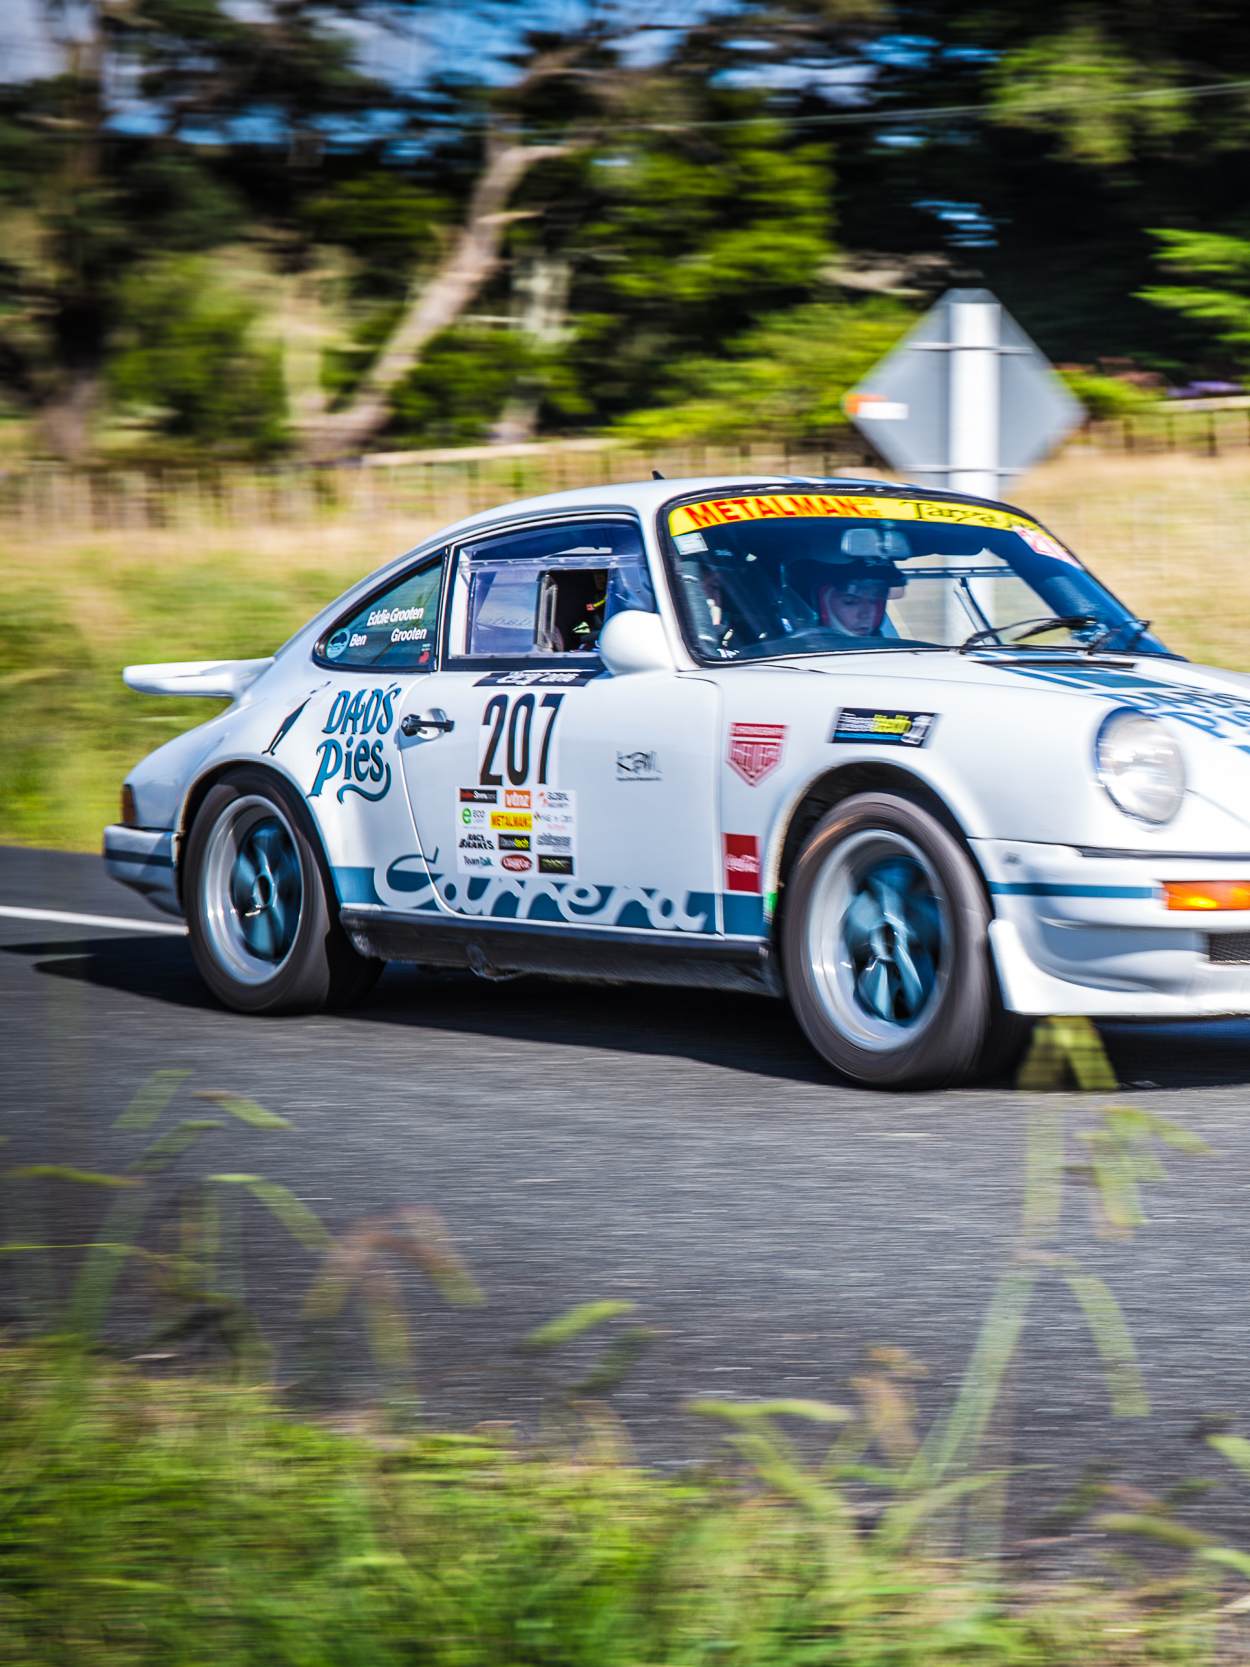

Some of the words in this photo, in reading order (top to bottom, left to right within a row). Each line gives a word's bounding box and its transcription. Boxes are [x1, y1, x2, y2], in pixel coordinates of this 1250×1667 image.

[683, 496, 866, 527] METALMAN
[901, 501, 999, 526] Targa
[366, 608, 391, 627] Eddie
[389, 606, 425, 624] Grooten
[348, 633, 368, 648] Ben
[390, 626, 428, 643] Grooten
[478, 692, 566, 787] 207
[305, 735, 392, 805] Pies
[505, 790, 531, 808] vtnz
[458, 838, 495, 851] BRAKES
[373, 847, 709, 932] Carrera
